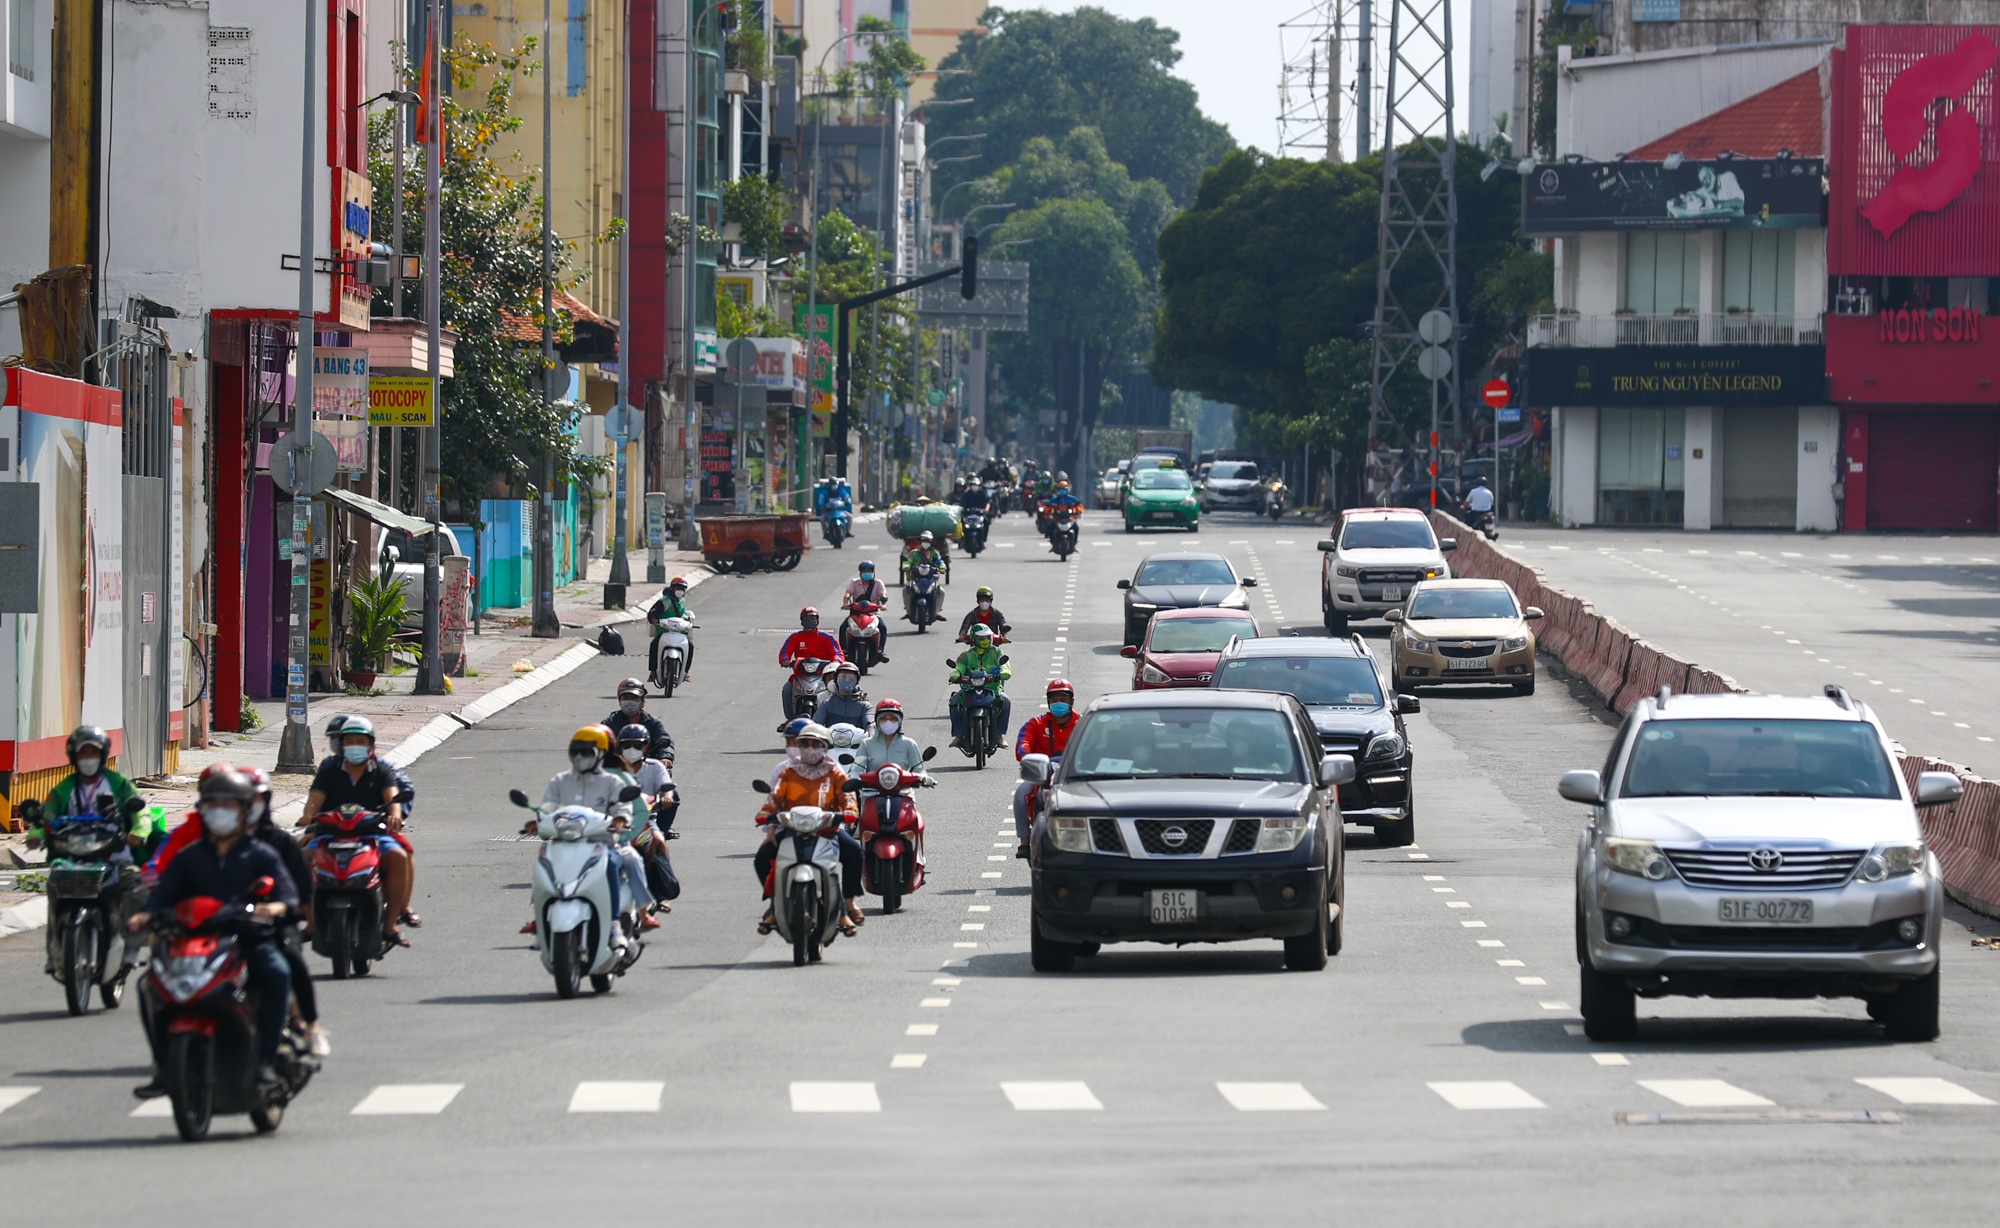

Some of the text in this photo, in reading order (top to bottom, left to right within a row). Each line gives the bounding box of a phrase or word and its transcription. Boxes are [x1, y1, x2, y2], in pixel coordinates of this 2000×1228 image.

[1880, 300, 1979, 342] NÓN SƠN
[323, 353, 350, 375] HÀNG
[353, 358, 365, 375] 43
[1654, 361, 1670, 369] THE
[1612, 371, 1782, 391] TRUNG NGUYÊN LEGEND
[371, 410, 392, 422] MÀU
[401, 413, 426, 422] SCAN
[701, 461, 731, 472] THEO
[1162, 892, 1186, 906] 61C
